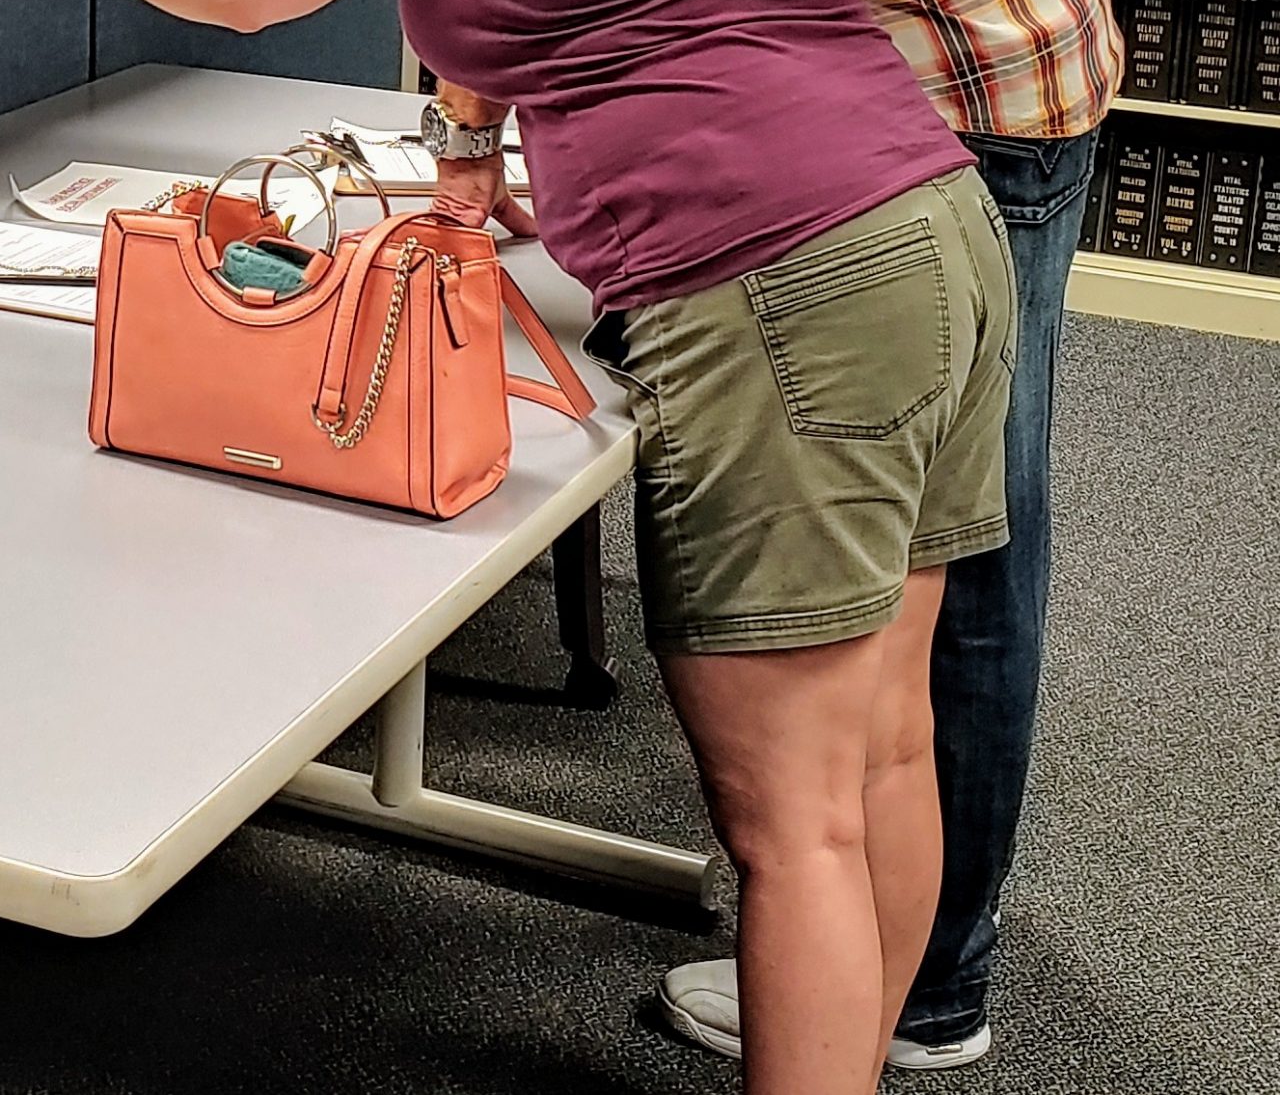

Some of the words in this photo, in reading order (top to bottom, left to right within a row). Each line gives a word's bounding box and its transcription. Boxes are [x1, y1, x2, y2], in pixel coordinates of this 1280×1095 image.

[1118, 191, 1145, 203] BIRTHS
[1167, 197, 1193, 210] BIRTHS
[1131, 234, 1140, 243] 17
